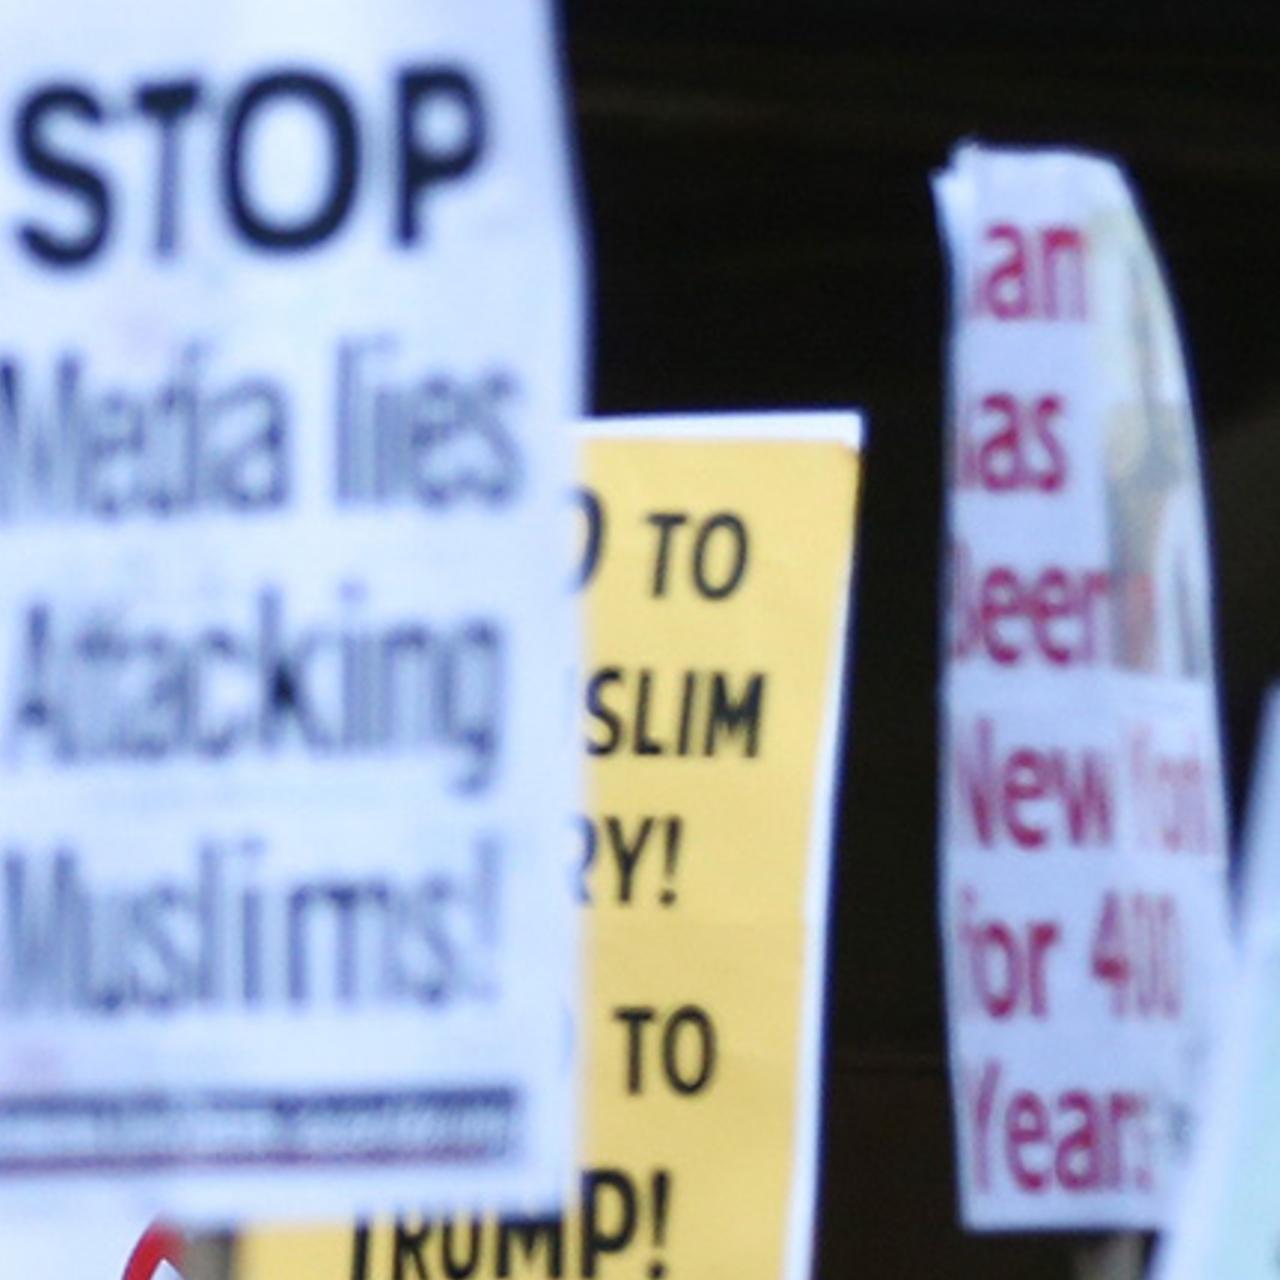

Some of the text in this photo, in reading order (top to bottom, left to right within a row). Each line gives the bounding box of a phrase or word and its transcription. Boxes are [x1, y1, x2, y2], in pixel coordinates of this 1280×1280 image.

[10, 62, 496, 275] STOP
[327, 332, 530, 518] lies
[646, 510, 752, 602] TO
[584, 664, 768, 760] SLIM
[612, 1002, 720, 1100] TO
